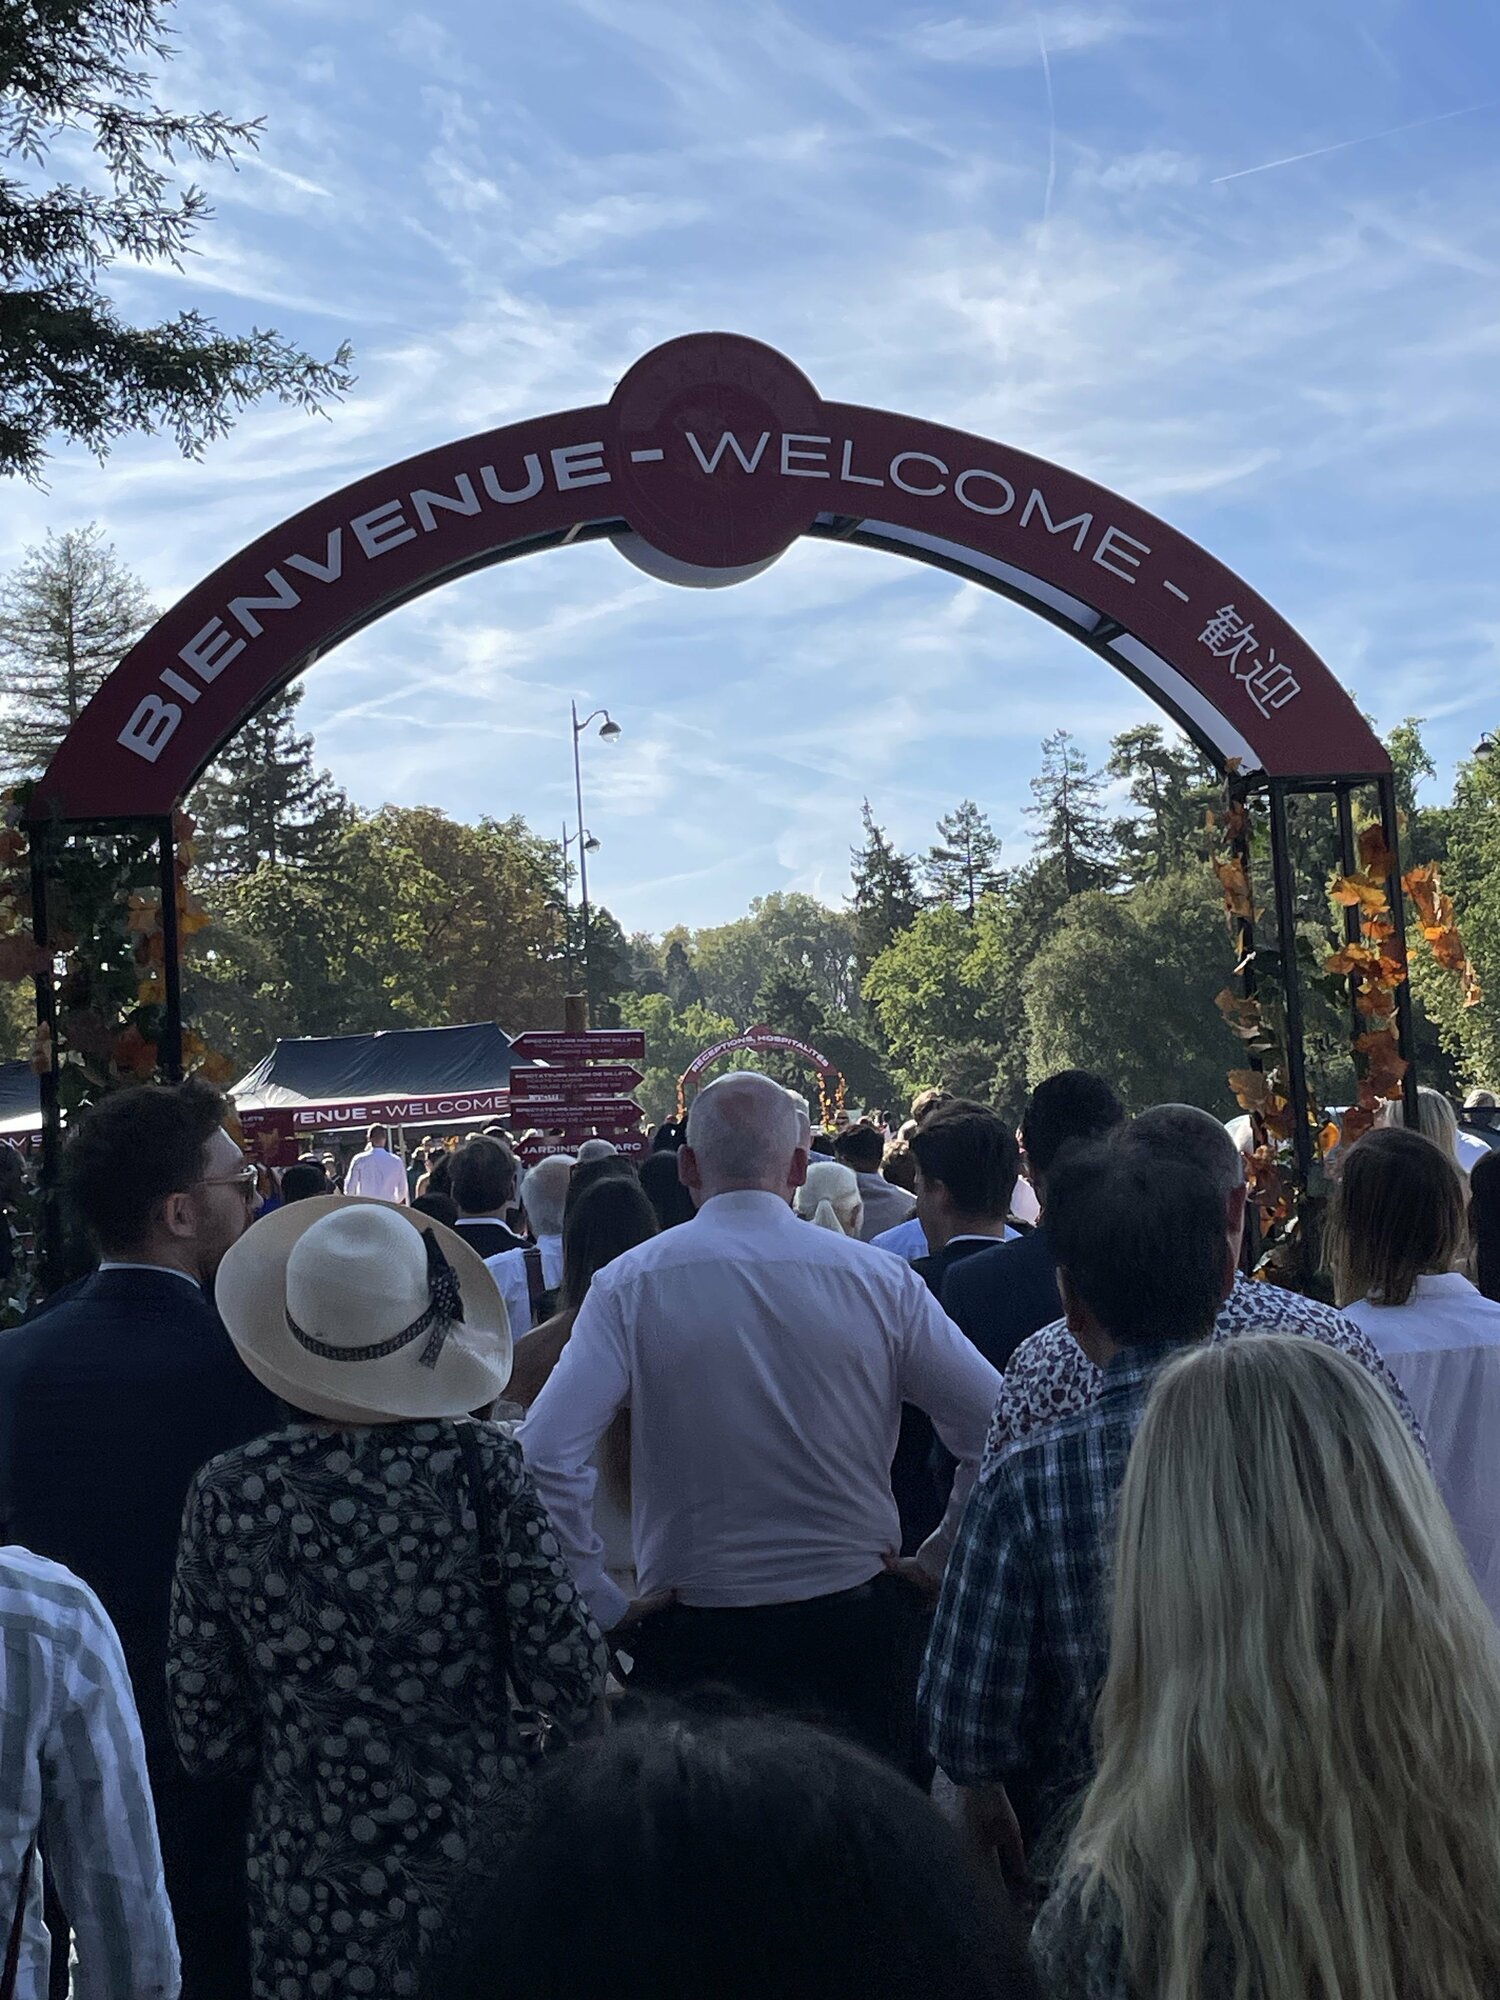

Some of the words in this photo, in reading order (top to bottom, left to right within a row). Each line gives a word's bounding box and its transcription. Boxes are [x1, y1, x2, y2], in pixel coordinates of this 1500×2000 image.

[117, 441, 611, 763] BIENVENUE
[685, 431, 1152, 585] WELCOME
[1197, 604, 1301, 719] 歓迎
[385, 1095, 509, 1117] WELCOME
[522, 1144, 579, 1155] JARDINS
